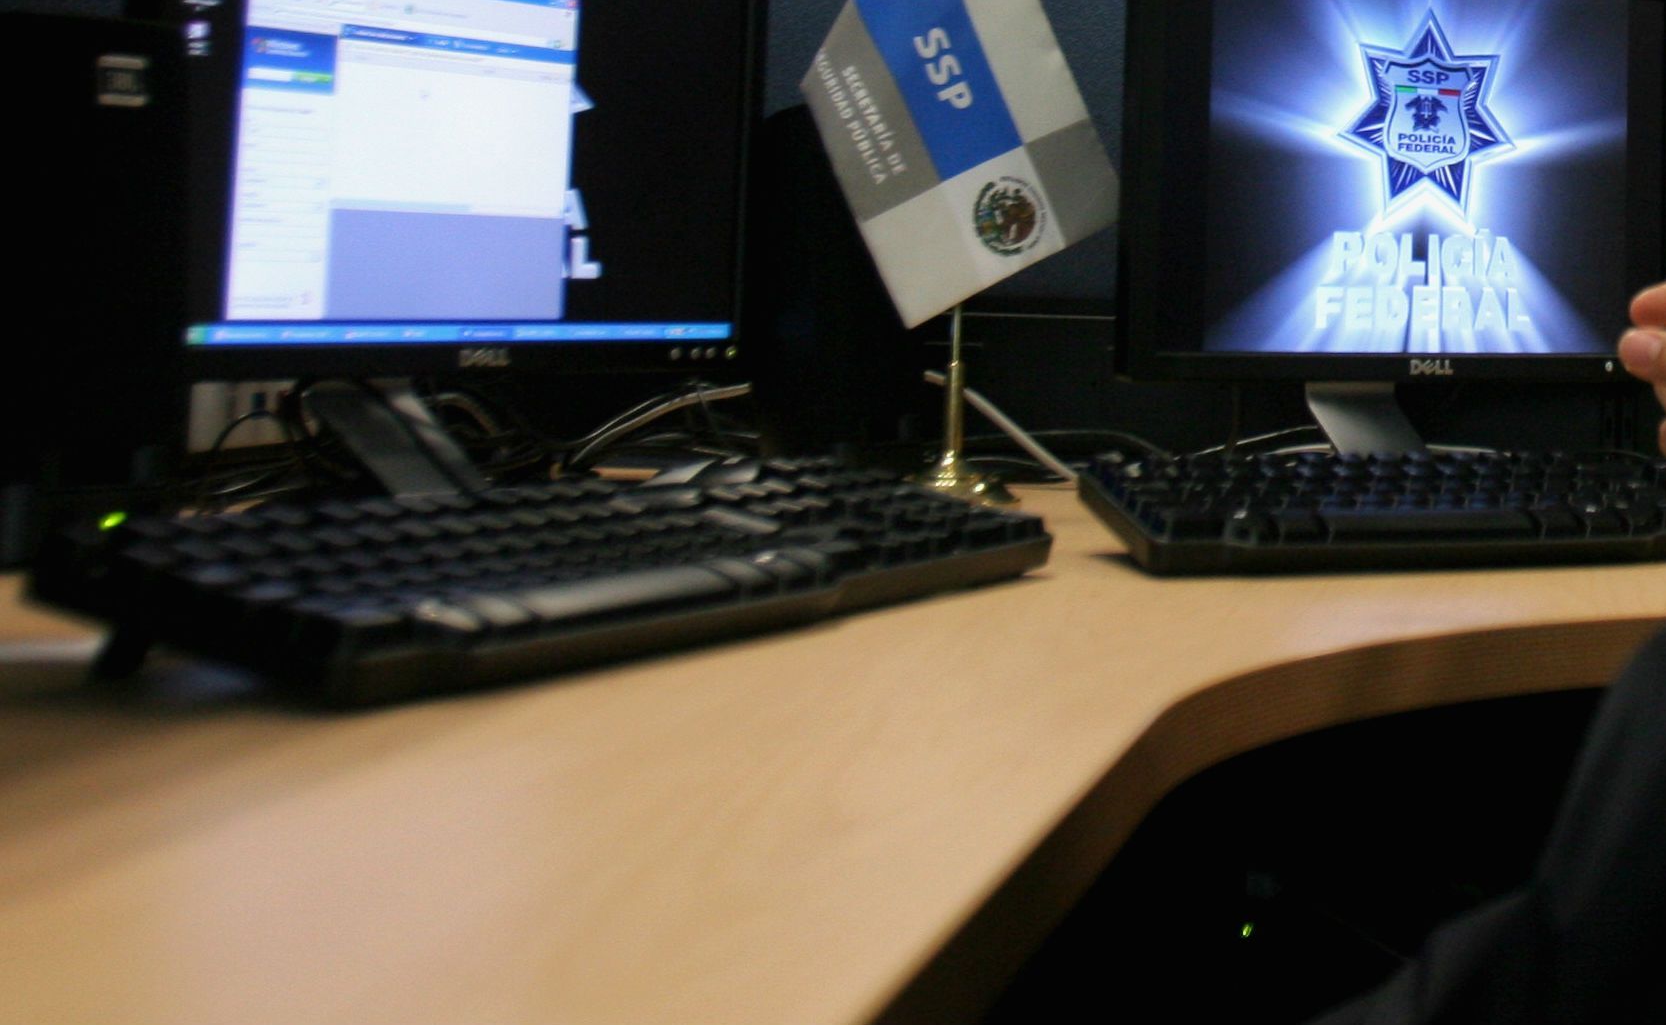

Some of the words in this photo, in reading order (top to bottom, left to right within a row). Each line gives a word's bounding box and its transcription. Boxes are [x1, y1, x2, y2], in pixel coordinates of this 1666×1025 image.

[913, 27, 974, 109] SSP
[1407, 69, 1450, 85] SSP
[841, 65, 895, 152] SECRETARÍA
[886, 152, 908, 176] DE
[1397, 132, 1456, 145] POLICÍA
[847, 119, 887, 185] PÚBLICA
[1397, 142, 1456, 155] FEDERAL
[1331, 228, 1518, 278] POLICÍA
[1315, 285, 1532, 330] FEDERAL
[1409, 359, 1454, 376] DELL
